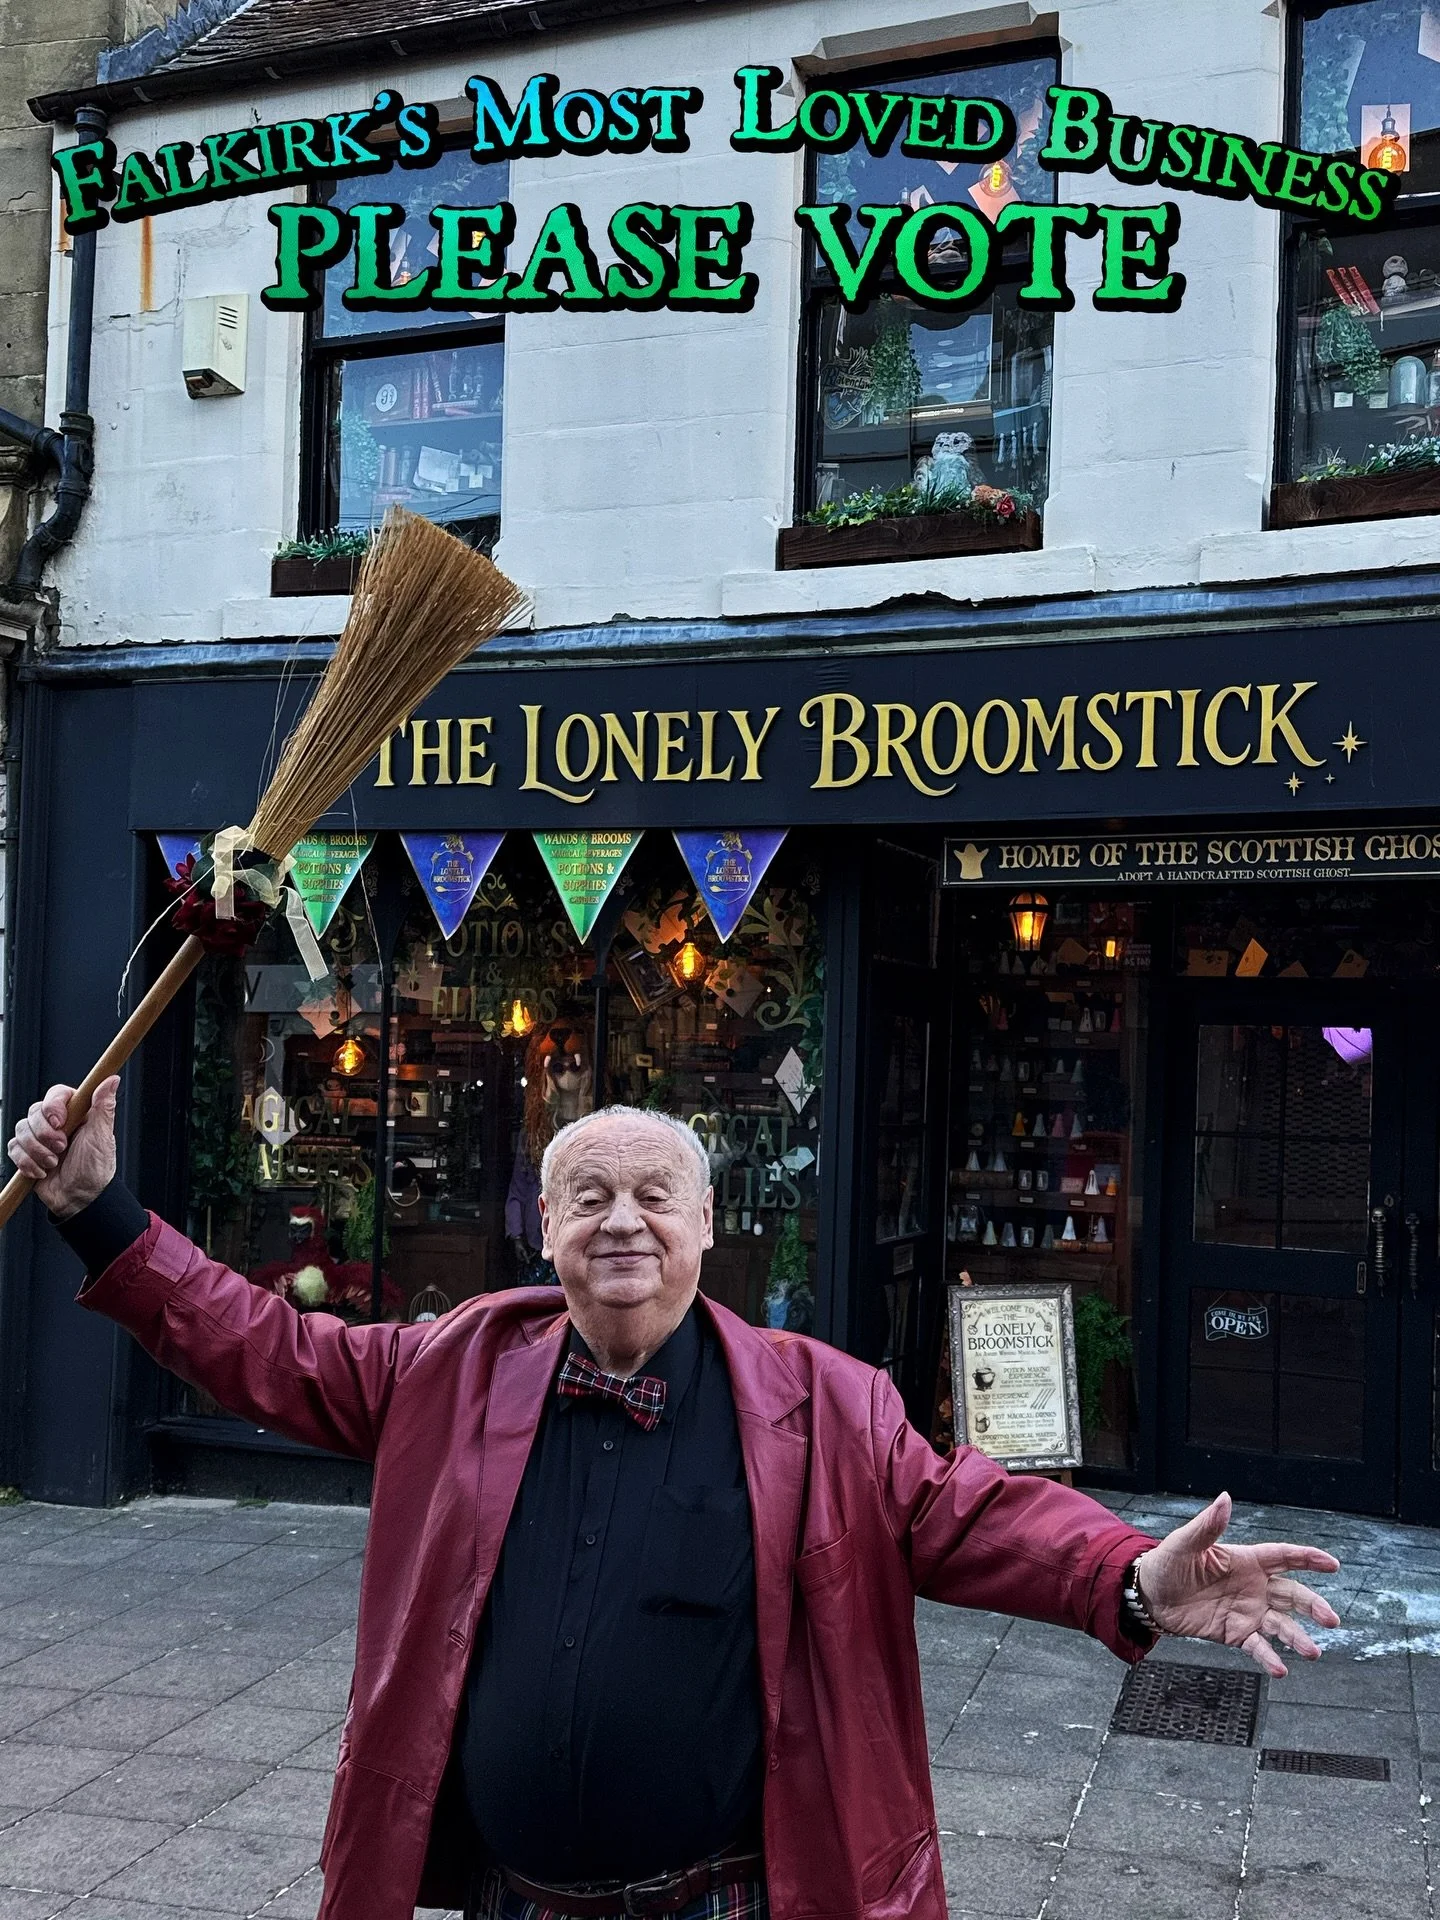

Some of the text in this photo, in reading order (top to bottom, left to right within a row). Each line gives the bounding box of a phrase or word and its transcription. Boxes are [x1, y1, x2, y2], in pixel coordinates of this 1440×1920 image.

[518, 704, 782, 803] LONELY
[798, 681, 1328, 797] BROOMSTICK
[330, 834, 368, 846] BROOMS
[543, 833, 578, 845] WANDS
[591, 833, 632, 845] BROOMS
[999, 845, 1081, 869] HOME
[1089, 843, 1128, 867] OF
[1135, 841, 1199, 866] THE
[1207, 837, 1356, 864] SCOTTISH
[297, 863, 352, 875] POTIONS &
[557, 863, 615, 875] POTIONS &
[1117, 867, 1351, 881] ADOPT A HANDCRAFTED SCOTTISH GHOST
[303, 879, 344, 890] SUPPLIES
[564, 880, 607, 891] SUPPLIES
[444, 919, 569, 959] OTIONS
[241, 1093, 359, 1137] AGICAL
[985, 1304, 1035, 1315] WELCOME TO
[985, 1322, 1036, 1336] LONELY
[1210, 1316, 1262, 1336] OPEN
[968, 1335, 1054, 1350] BROOMSTICK
